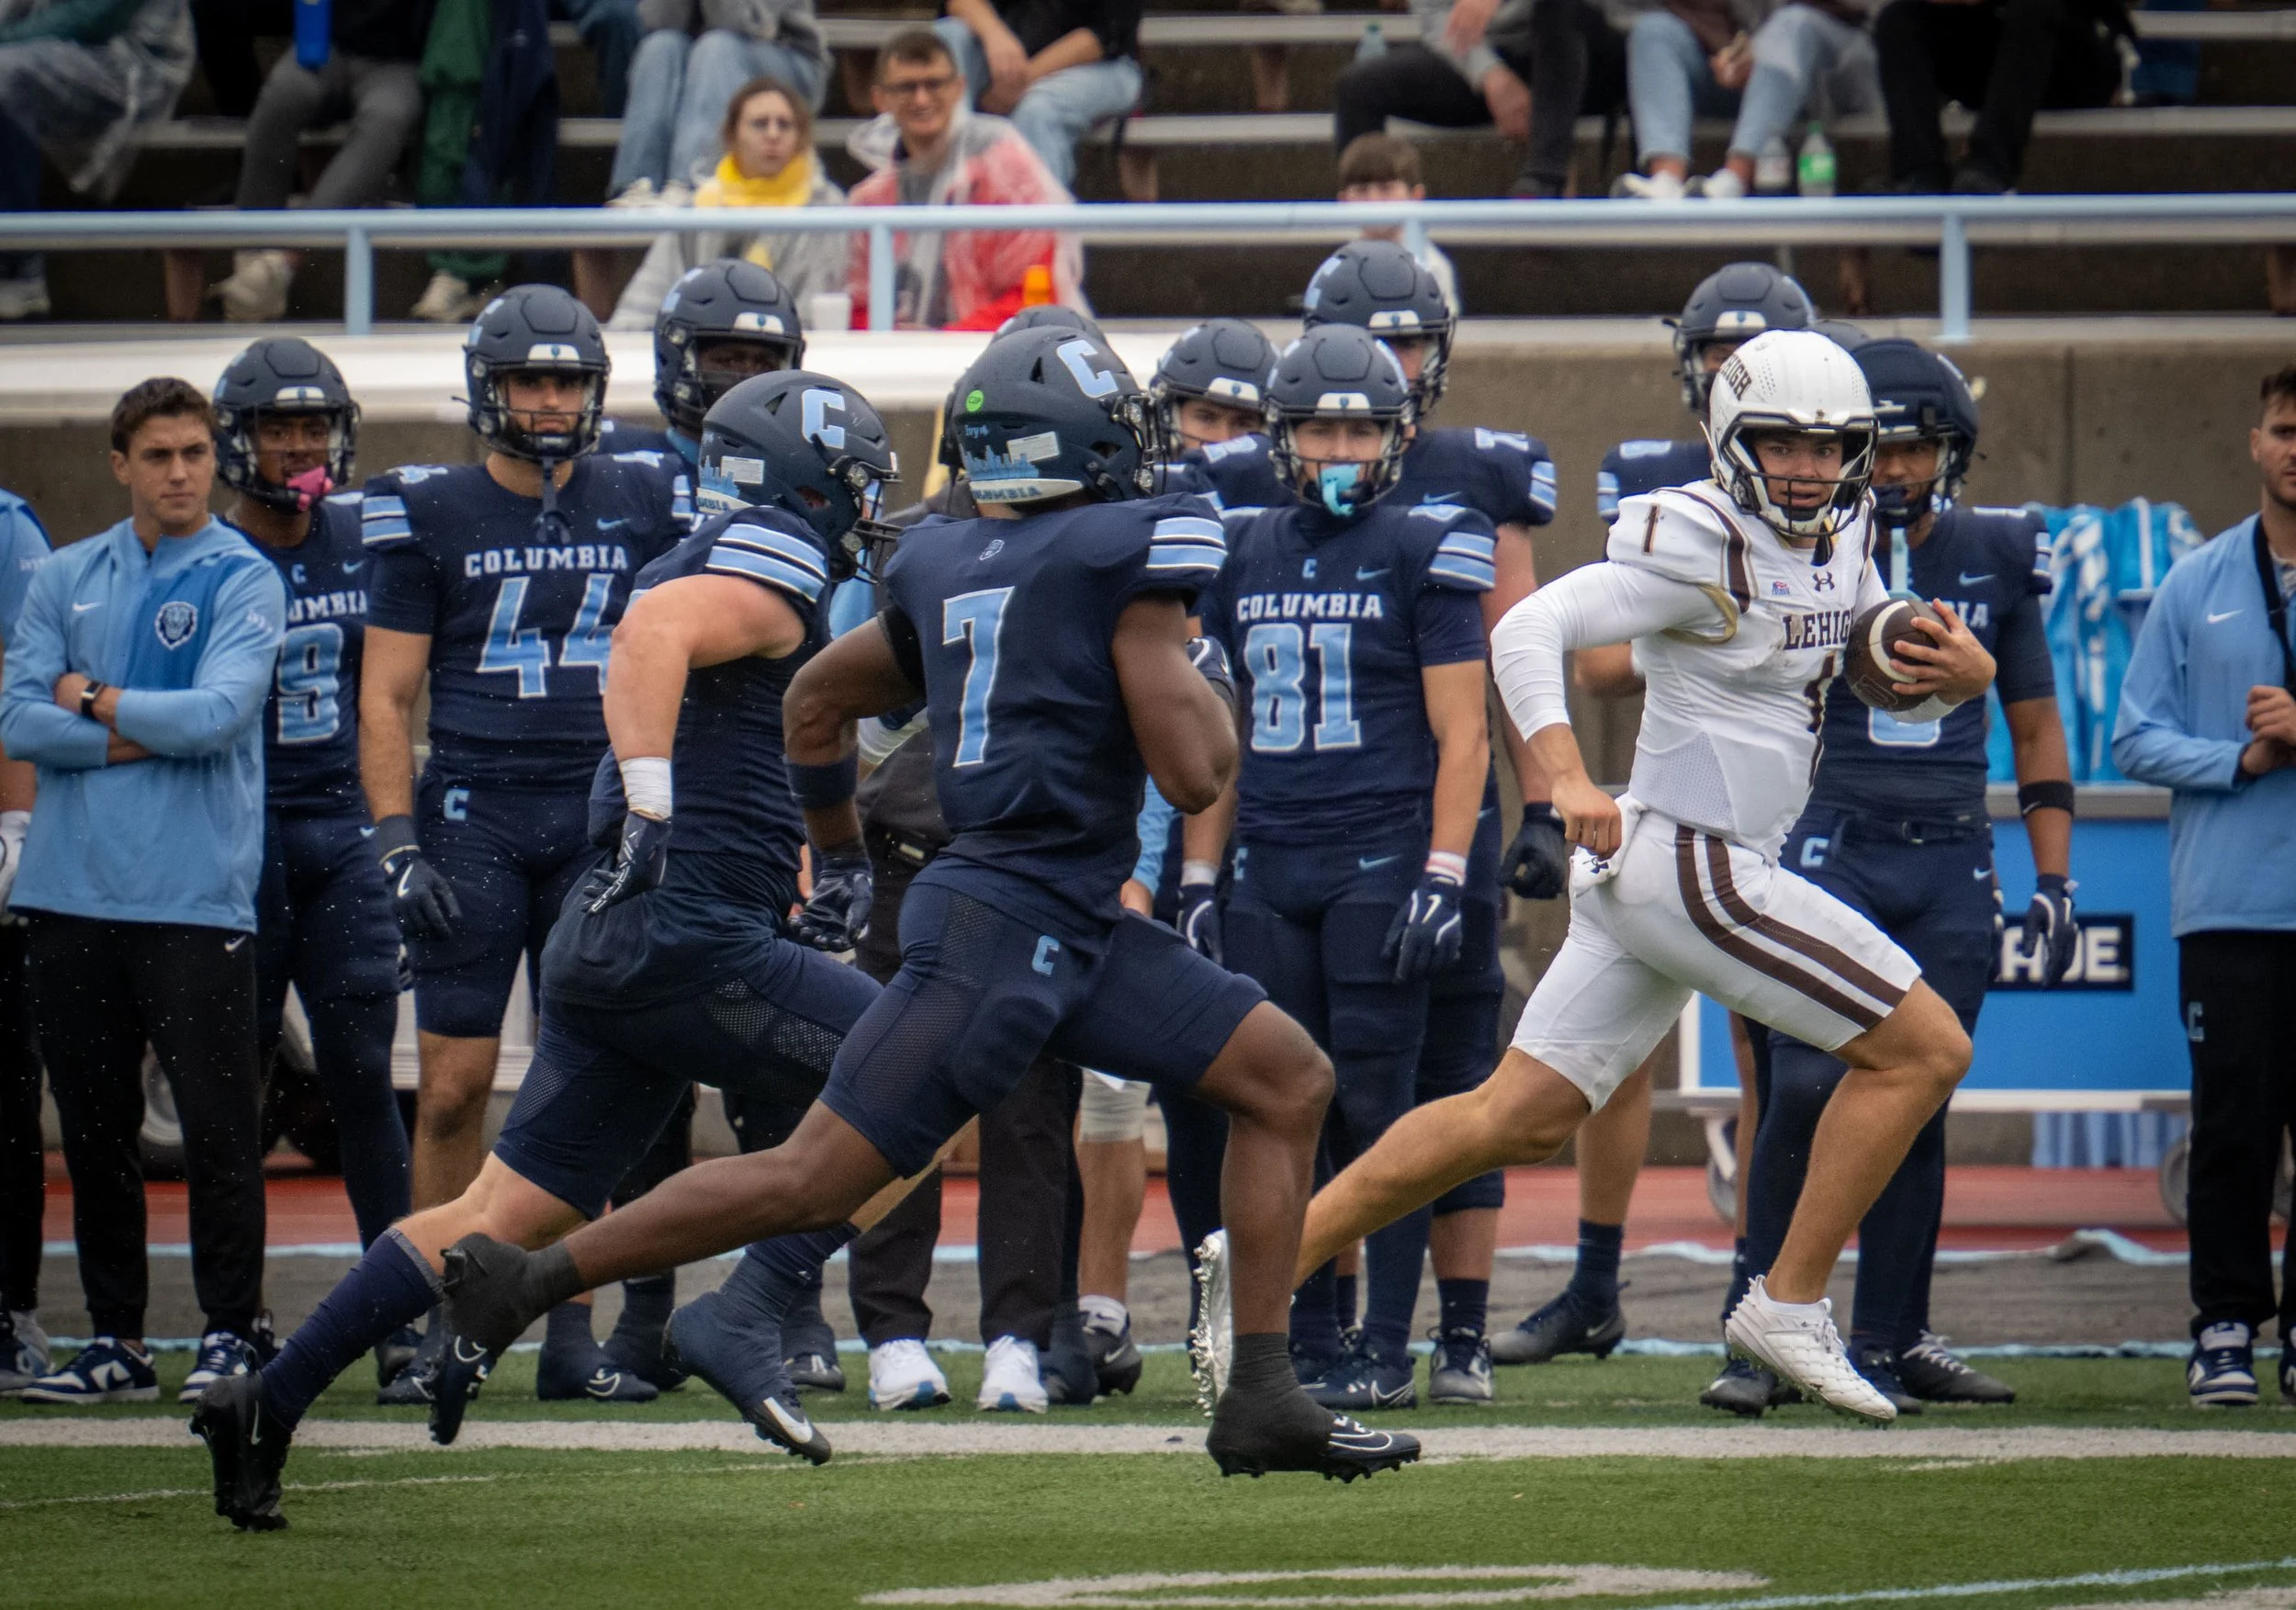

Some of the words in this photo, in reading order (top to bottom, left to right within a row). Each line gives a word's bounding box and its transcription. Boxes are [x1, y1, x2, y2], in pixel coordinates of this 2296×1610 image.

[1056, 340, 1119, 399] C
[802, 388, 846, 450] C
[1641, 502, 1660, 557] 1
[291, 563, 307, 584] C
[464, 545, 628, 578] COLUMBIA
[1301, 557, 1318, 580] C
[288, 589, 367, 623] UMBIA
[1236, 592, 1385, 623] COLUMBIA
[476, 573, 616, 699] 44
[277, 622, 344, 746] 9
[942, 586, 1015, 768] 7
[1244, 622, 1362, 751] 81
[443, 788, 470, 821] C
[1800, 836, 1830, 869] C
[1031, 934, 1060, 978] C
[2188, 1000, 2205, 1043] C
